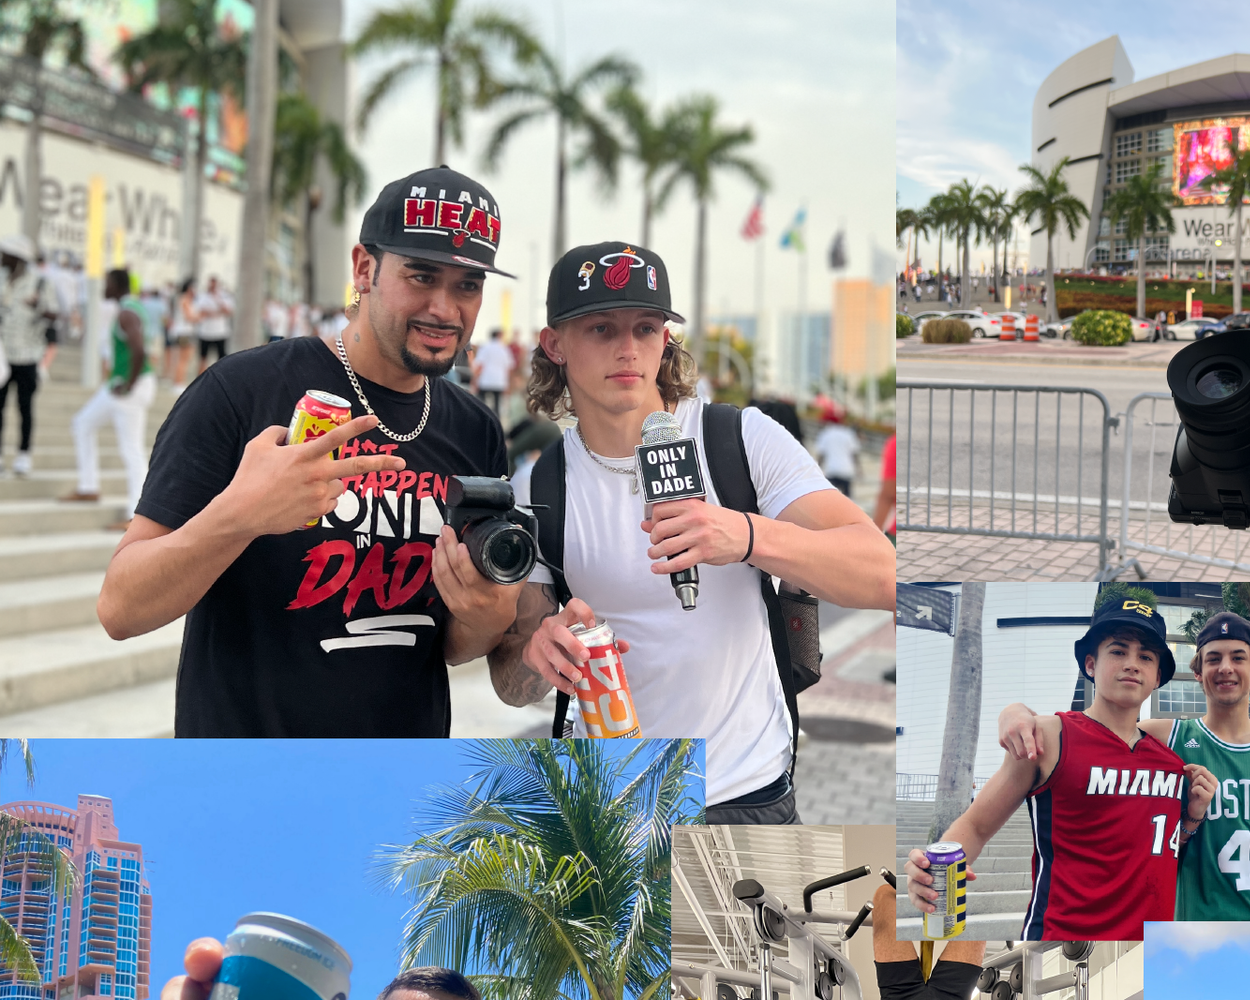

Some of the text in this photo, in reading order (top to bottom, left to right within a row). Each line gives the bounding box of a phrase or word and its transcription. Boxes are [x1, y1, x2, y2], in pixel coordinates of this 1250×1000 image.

[410, 185, 499, 217] MIAMI
[404, 197, 501, 244] HEAT
[1183, 218, 1235, 238] Wear
[646, 445, 688, 465] ONLY
[341, 469, 449, 501] HAPPEN
[651, 475, 695, 495] DADE
[659, 464, 678, 479] IN
[356, 533, 372, 549] IN
[284, 539, 434, 618] DAD
[588, 649, 635, 732] C4
[1087, 766, 1185, 801] MIAMI
